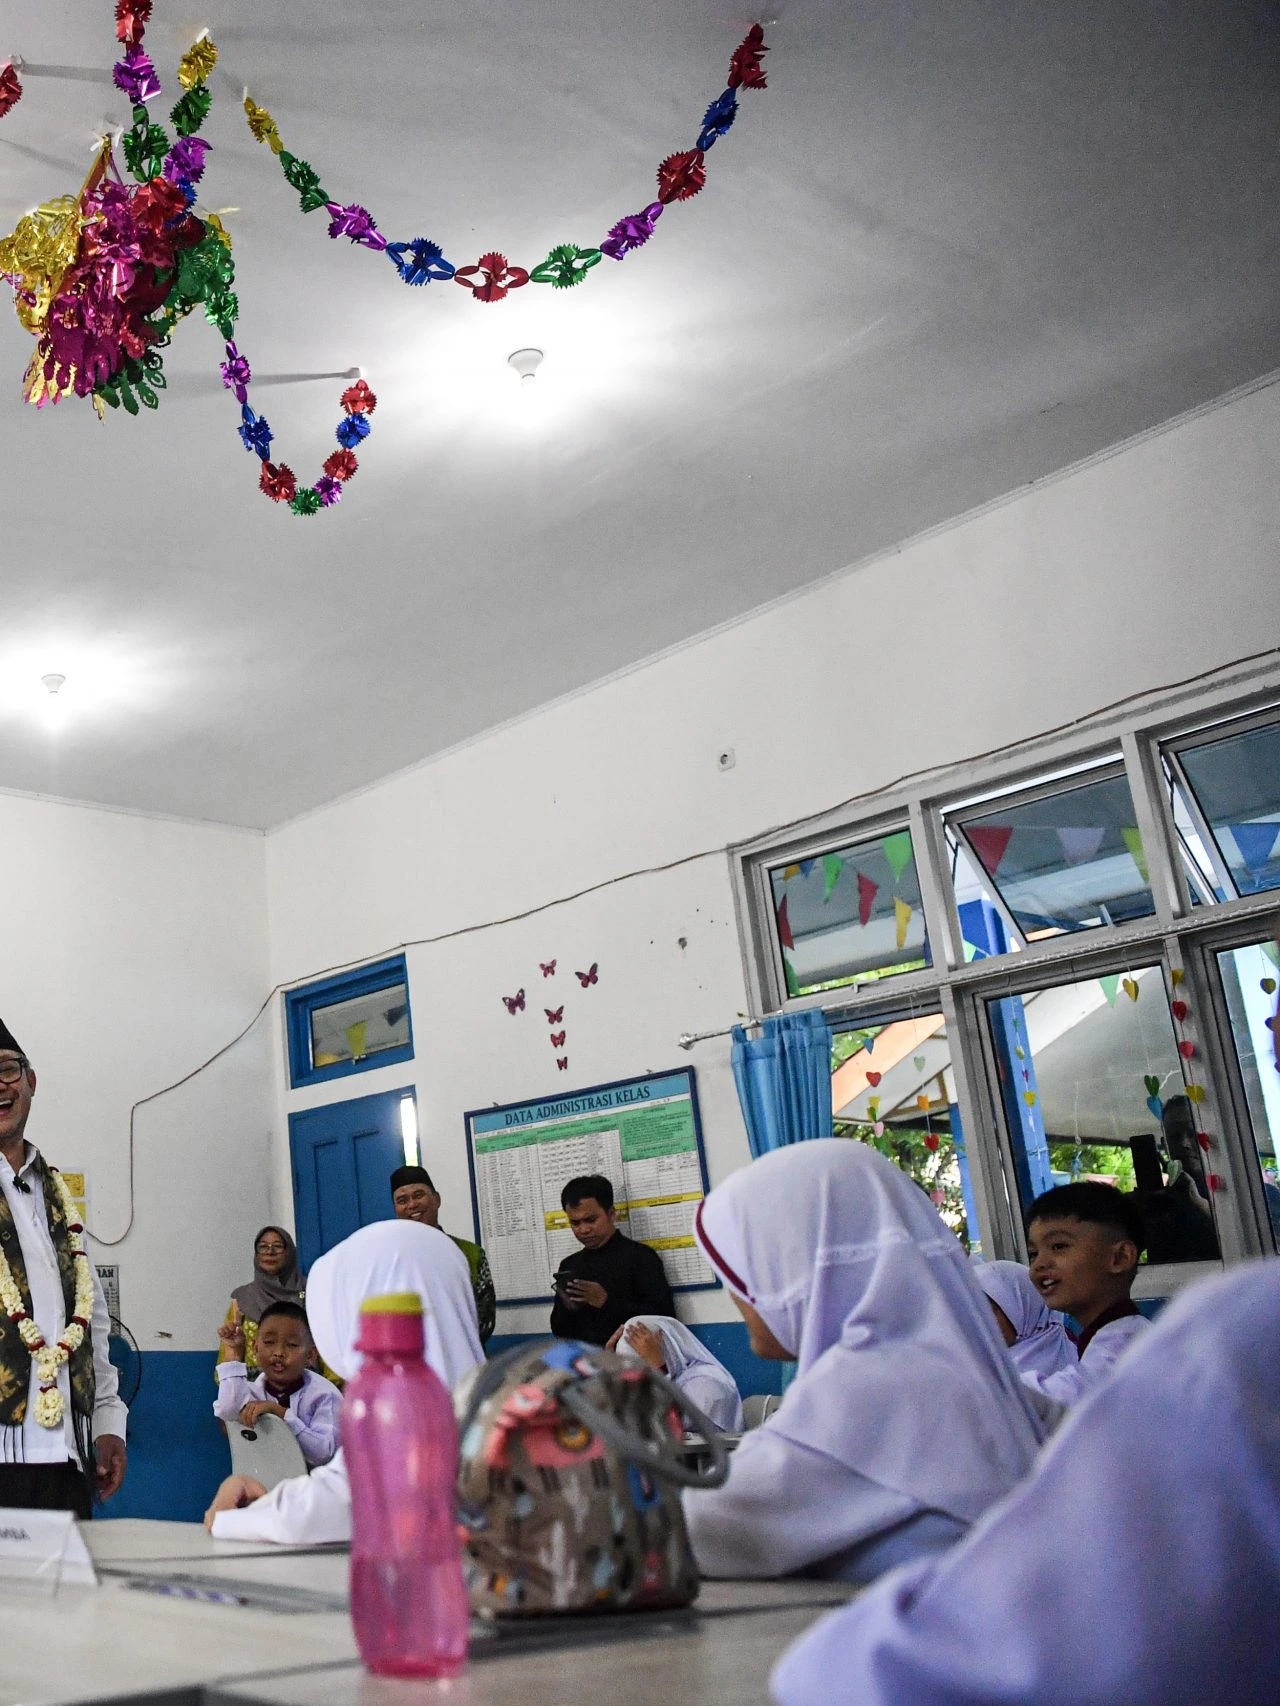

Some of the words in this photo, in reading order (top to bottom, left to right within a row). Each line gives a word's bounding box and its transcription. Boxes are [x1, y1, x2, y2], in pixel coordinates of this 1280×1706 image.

[504, 1109, 534, 1126] DATA
[536, 1093, 612, 1119] ADMINISTRASI
[616, 1085, 651, 1104] KELAS
